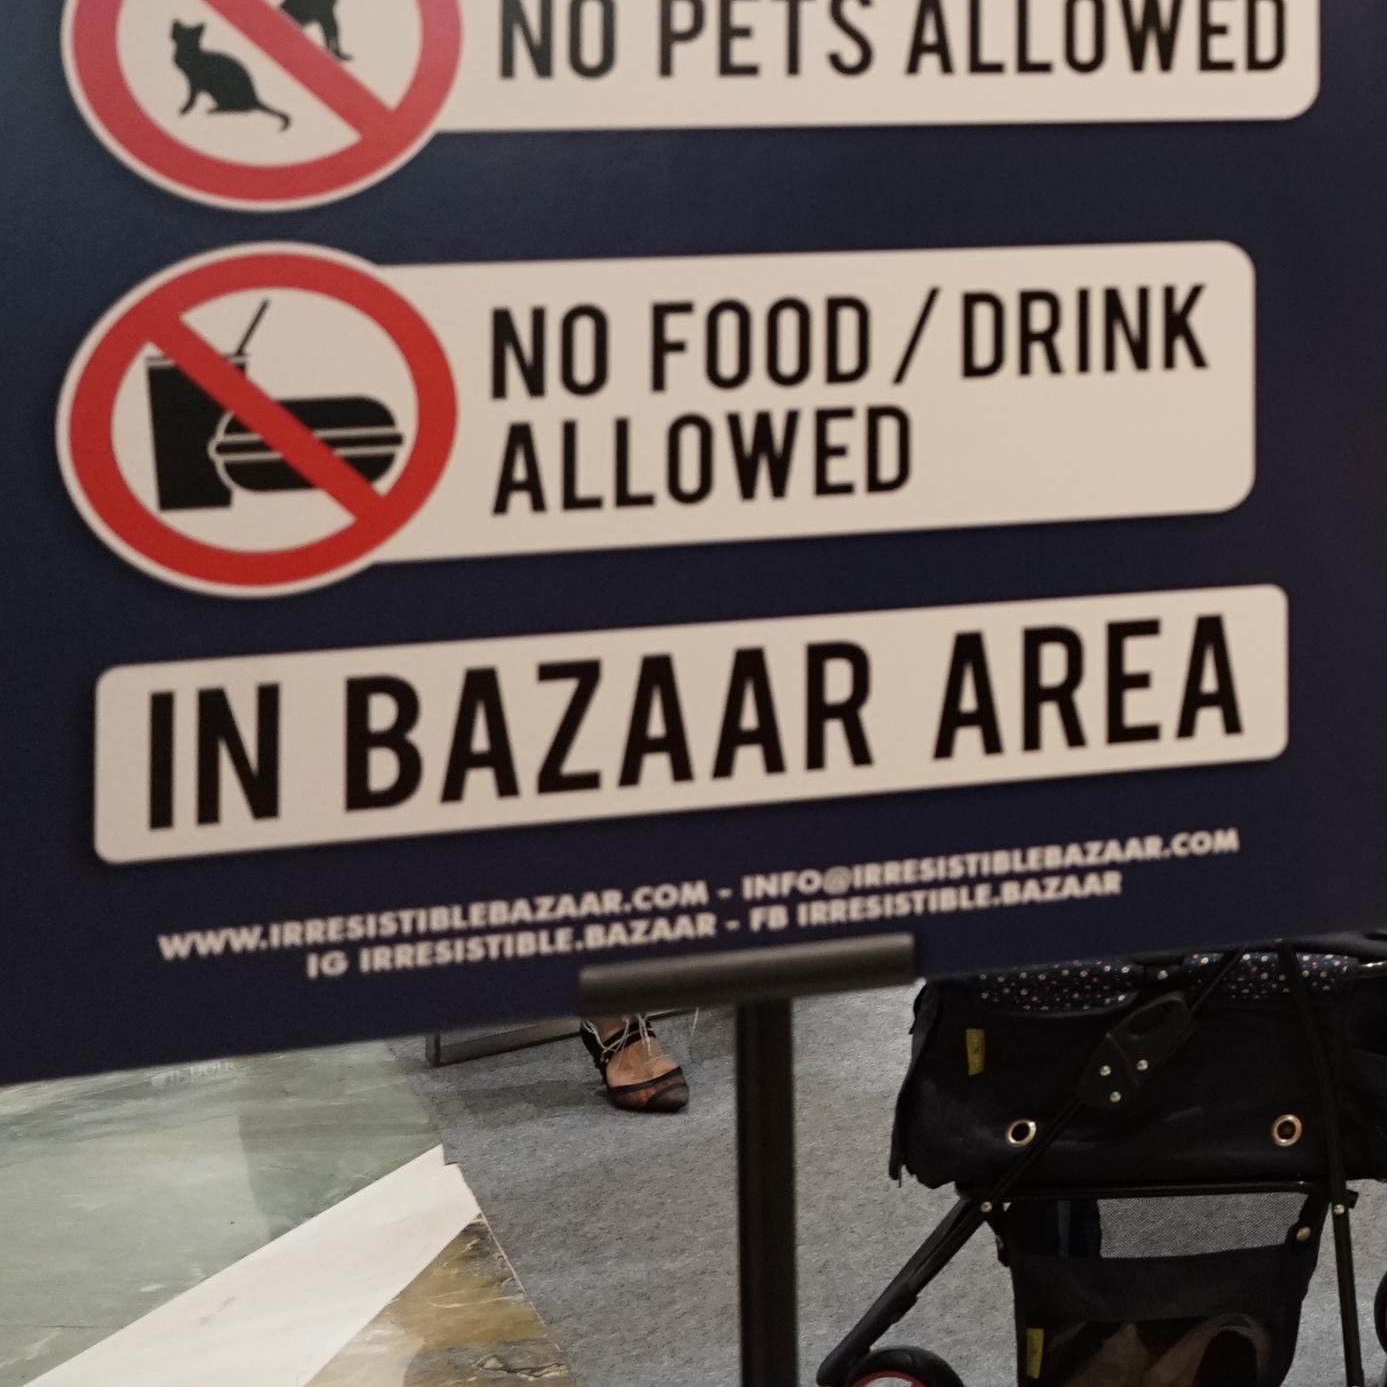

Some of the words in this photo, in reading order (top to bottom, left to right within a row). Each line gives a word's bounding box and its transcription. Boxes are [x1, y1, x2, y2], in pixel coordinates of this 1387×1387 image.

[491, 304, 609, 400] NO
[492, 406, 912, 515] ALLOWED
[148, 683, 280, 830] IN
[344, 641, 874, 813] BAZAAR
[932, 613, 1243, 759] AREA
[158, 881, 707, 960] WWW.IRRESISTIBLEBAZAAR.COM
[743, 827, 1240, 901] INFO@IRRESISTIBLEBAZAAR.COM
[307, 952, 349, 979] IG
[360, 913, 717, 973] IRRESISTIBLE.BAZAAR
[749, 905, 789, 933] FB
[798, 871, 1122, 927] IRRESISTIBLE.BAZAAR
